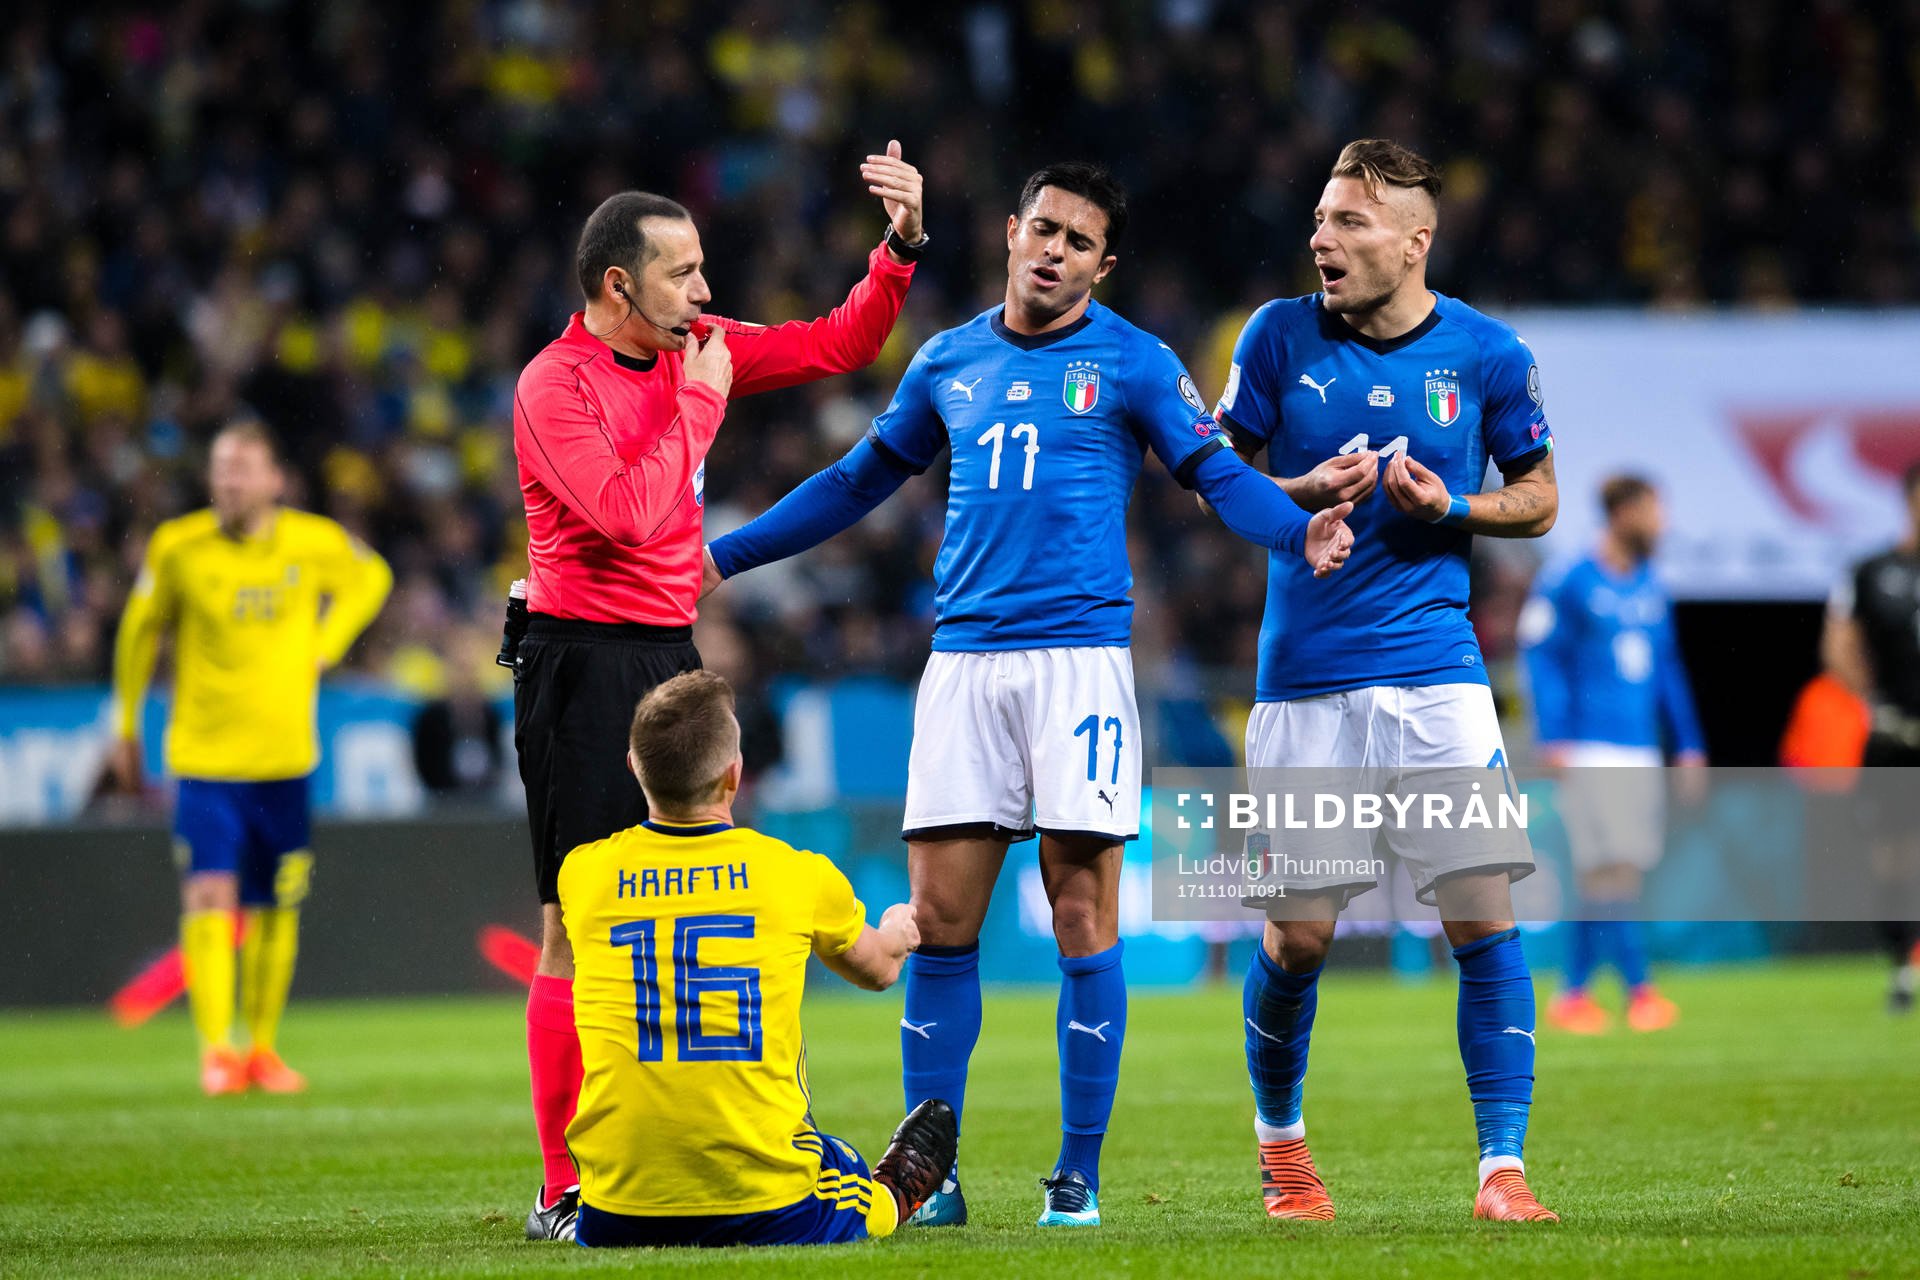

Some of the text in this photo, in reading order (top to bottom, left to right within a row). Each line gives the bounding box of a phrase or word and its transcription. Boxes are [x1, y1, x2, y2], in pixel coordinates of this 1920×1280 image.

[1068, 372, 1097, 381] ITALIA
[1428, 381, 1456, 390] ITALIA
[977, 422, 1040, 490] 17
[1073, 714, 1123, 785] 17
[609, 914, 763, 1062] 16
